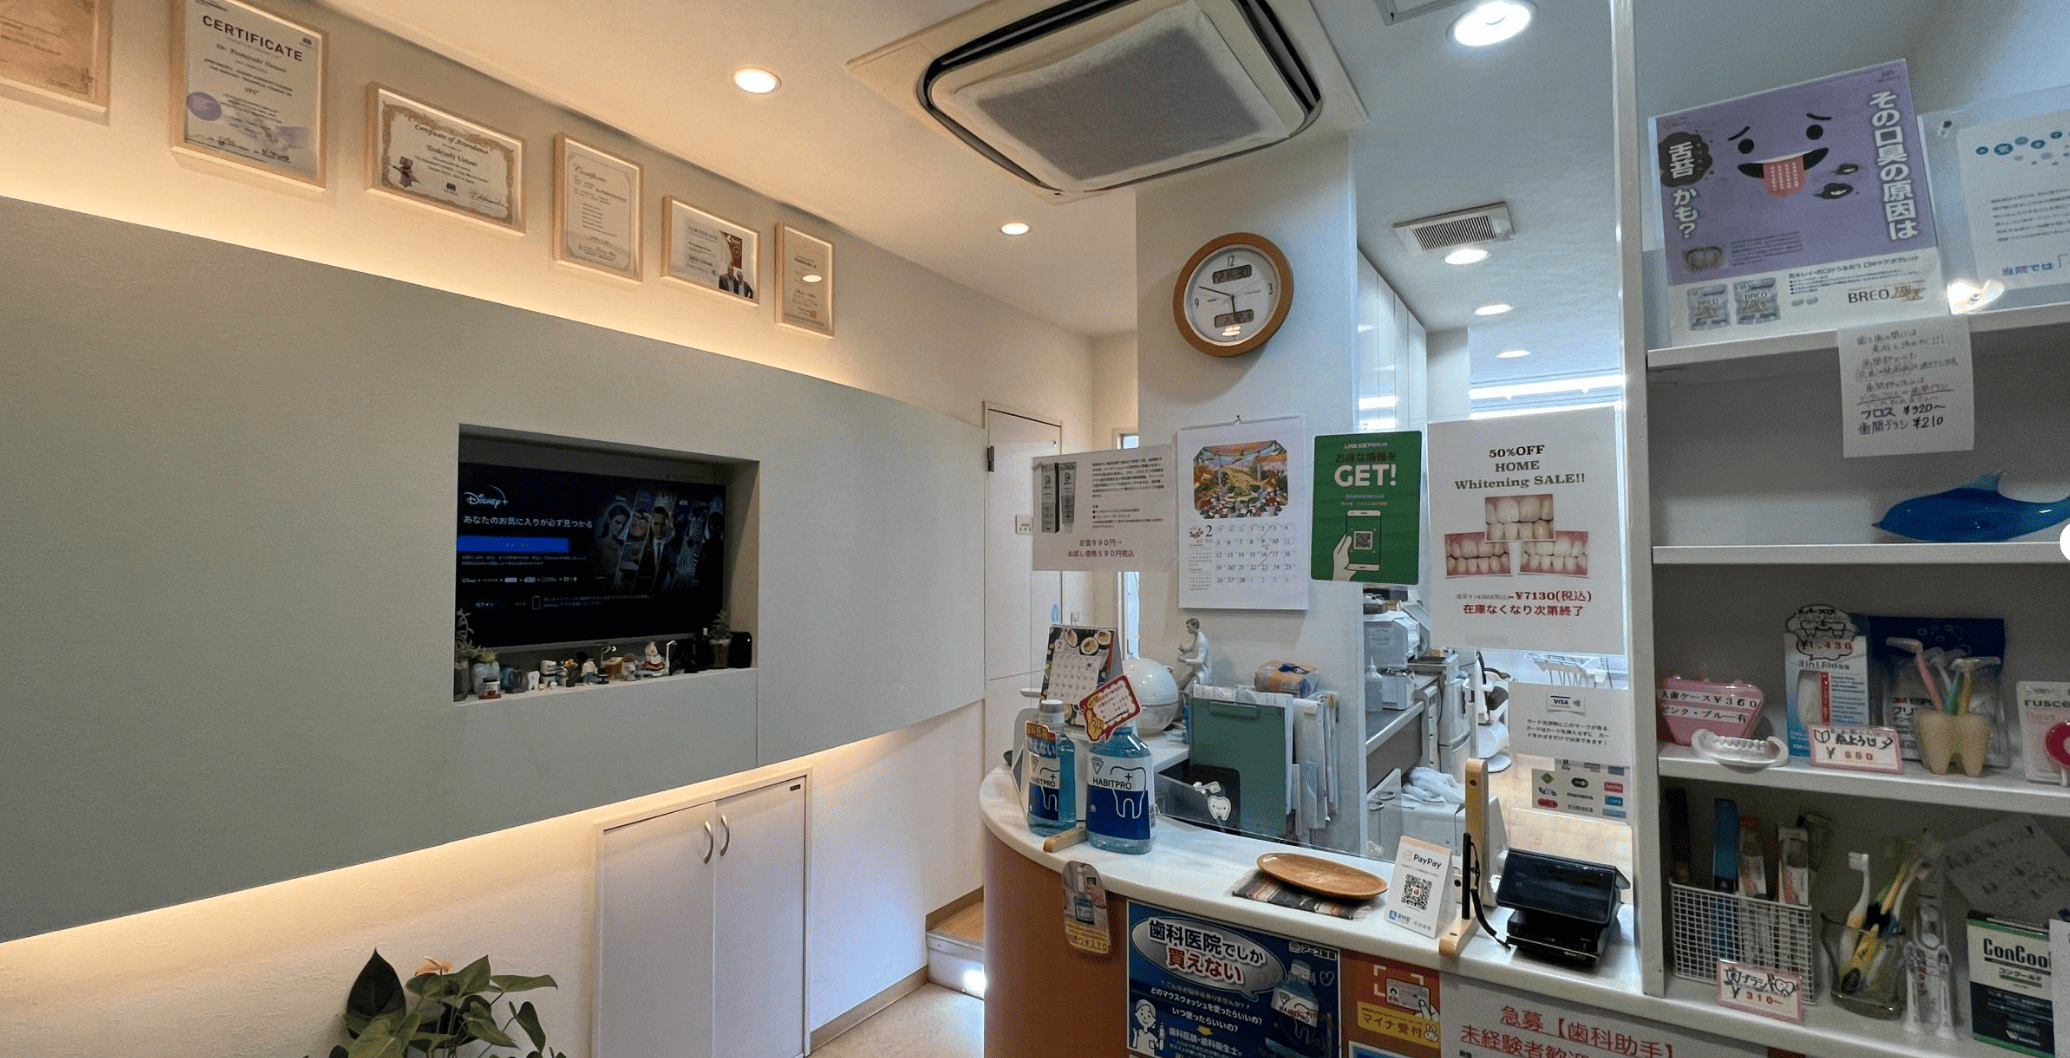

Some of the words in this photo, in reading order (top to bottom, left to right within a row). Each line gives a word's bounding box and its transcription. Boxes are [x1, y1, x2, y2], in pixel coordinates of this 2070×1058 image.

[202, 15, 302, 61] CERTIFICATE
[414, 124, 447, 139] Certificate
[1869, 91, 1918, 240] その口臭の原因は
[1227, 255, 1235, 266] 12
[1267, 283, 1274, 295] 3
[1848, 288, 1890, 304] BREO
[1194, 298, 1200, 309] 9
[1860, 406, 1896, 420] フロス
[1857, 418, 1909, 436] 歯間ブラシ
[1912, 415, 1944, 430] ¥210
[1336, 451, 1396, 463] お得な情報を
[1489, 444, 1545, 458] 50%OFF
[1495, 460, 1540, 472] HOME
[1334, 464, 1397, 487] GET!
[1454, 477, 1530, 490] Whitening
[1534, 473, 1585, 486] SALE!!
[463, 488, 508, 509] Disney+
[463, 515, 593, 529] あなたのお気に入りが必ず見つかる
[1205, 524, 1213, 537] 2
[1463, 603, 1583, 616] 在庫なくなり次第終了
[1821, 661, 1850, 670] Floss
[1844, 750, 1873, 761] 550
[1092, 776, 1133, 790] HABITPRO
[1413, 853, 1441, 869] PayPay
[1149, 920, 1264, 963] 歯科医院でしか
[1167, 947, 1243, 982] 買えない
[1150, 985, 1263, 1025] どのマウスウォッシュを使ったらいいの?
[1171, 1007, 1239, 1032] いつ使ったらいいの?
[1362, 1012, 1422, 1039] マイナ受付
